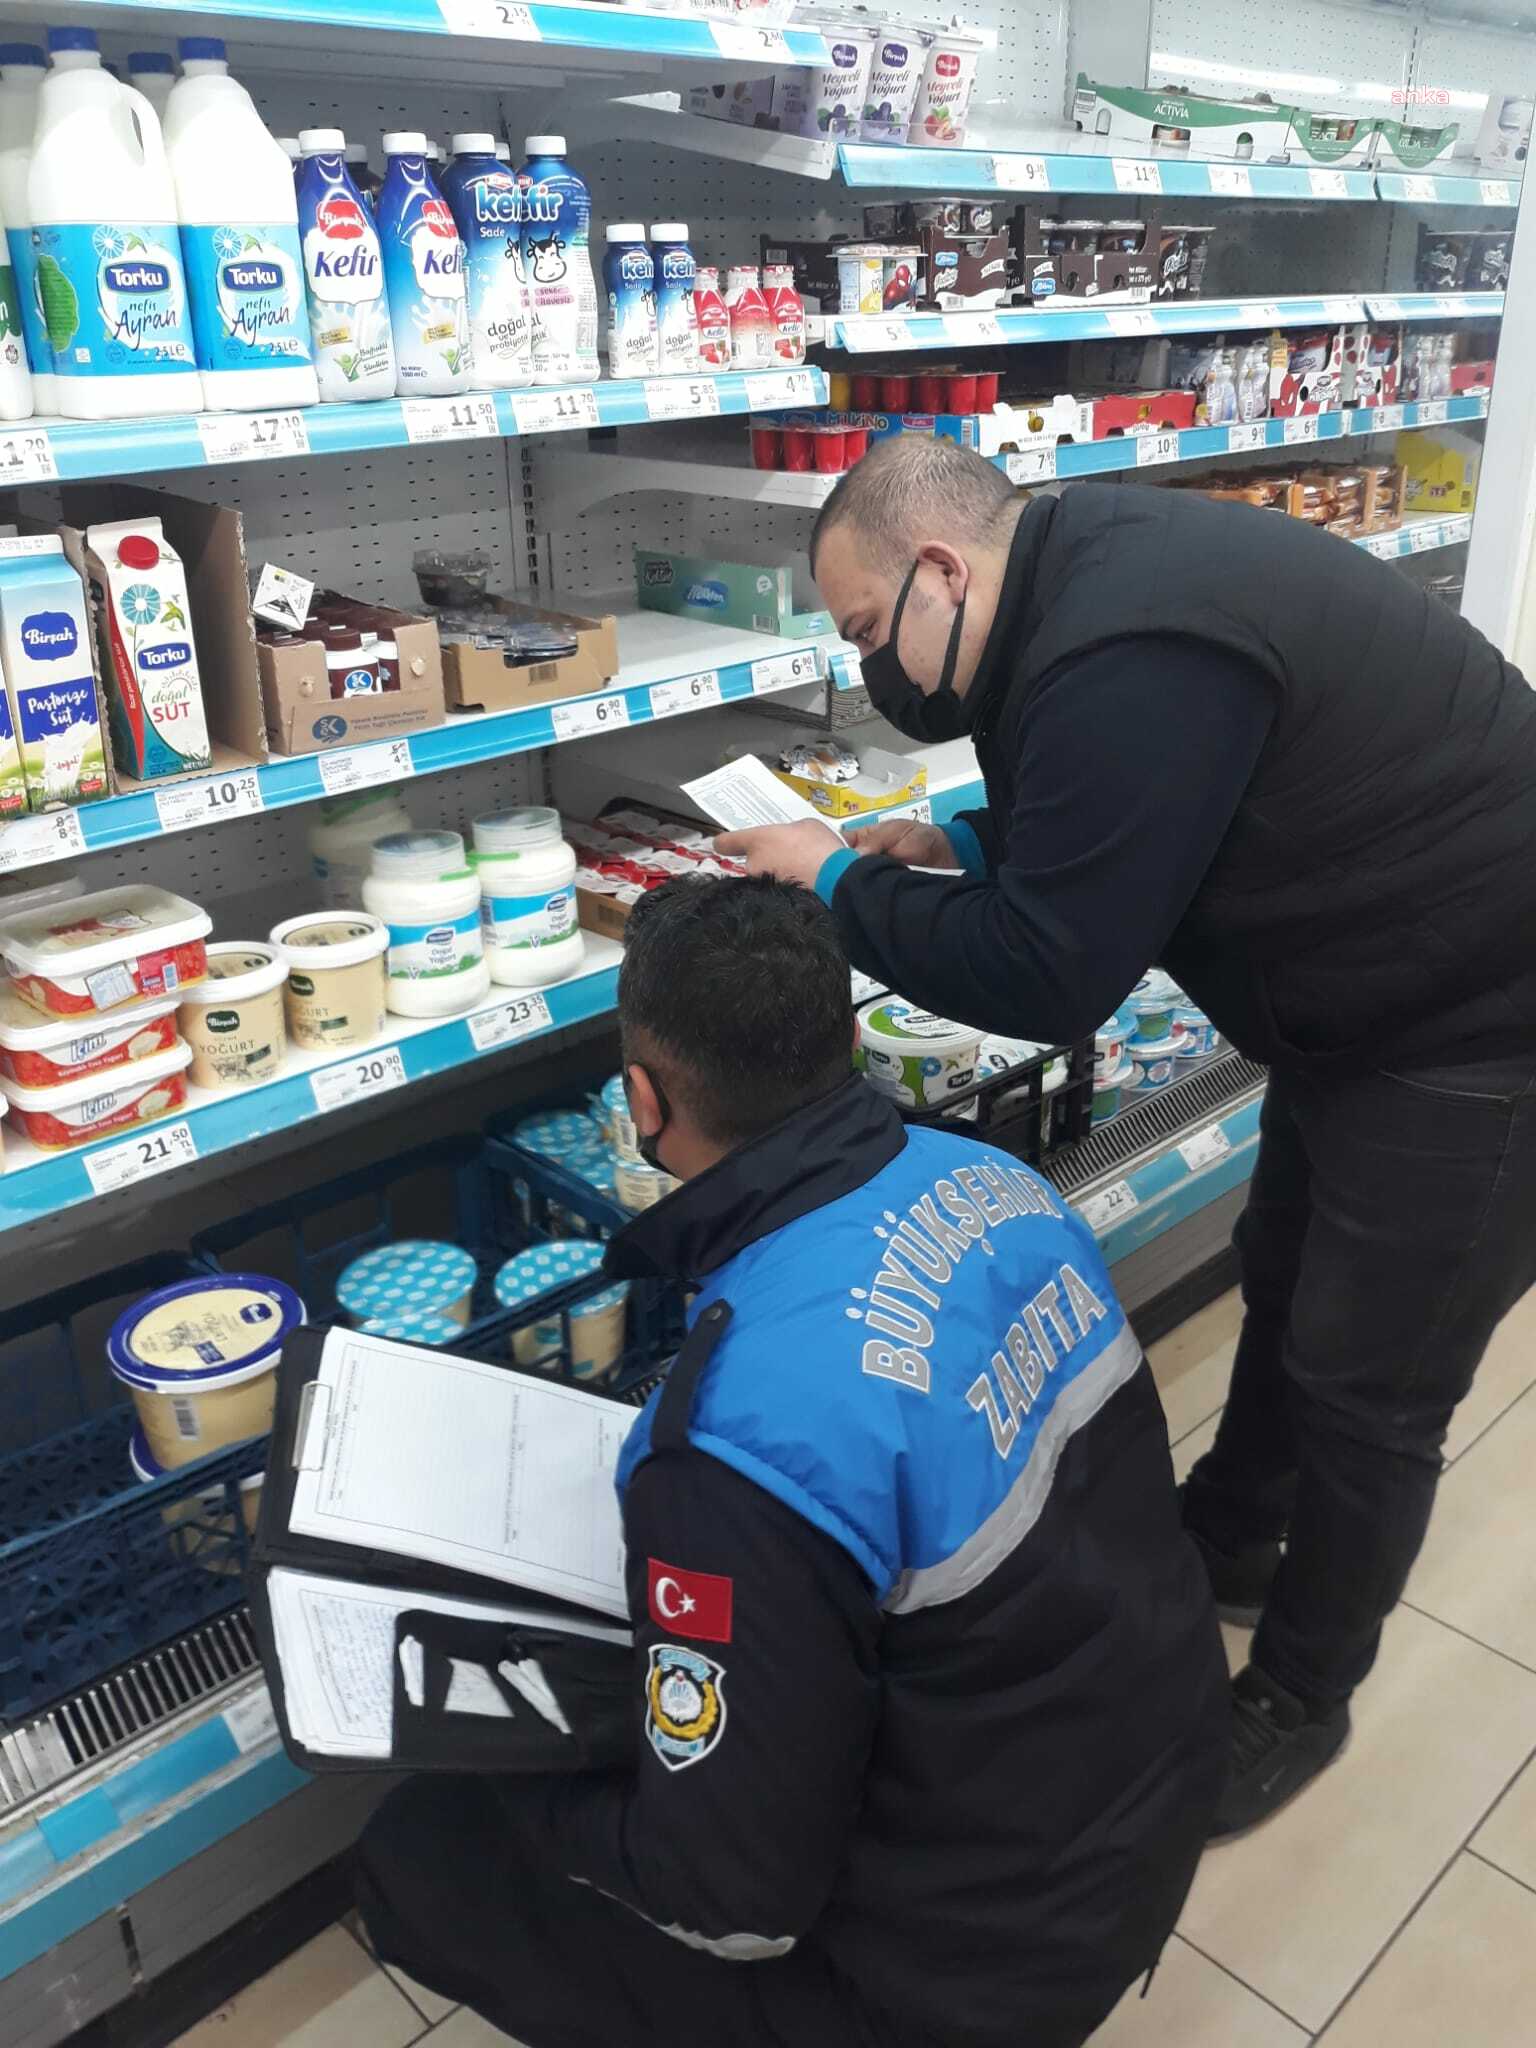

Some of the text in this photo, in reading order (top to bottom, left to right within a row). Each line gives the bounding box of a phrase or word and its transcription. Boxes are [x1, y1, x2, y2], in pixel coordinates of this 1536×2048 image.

[1154, 104, 1190, 119] ACTIVIA
[480, 227, 505, 238] Sade
[314, 244, 378, 278] Kefir
[109, 269, 163, 287] Torku
[228, 268, 277, 285] Torku
[113, 304, 177, 351] Ayran
[229, 303, 291, 347] Ayran
[25, 627, 74, 645] Birşah
[143, 648, 186, 666] Torku
[152, 684, 187, 704] doğal
[965, 1263, 1108, 1461] ZABITA
